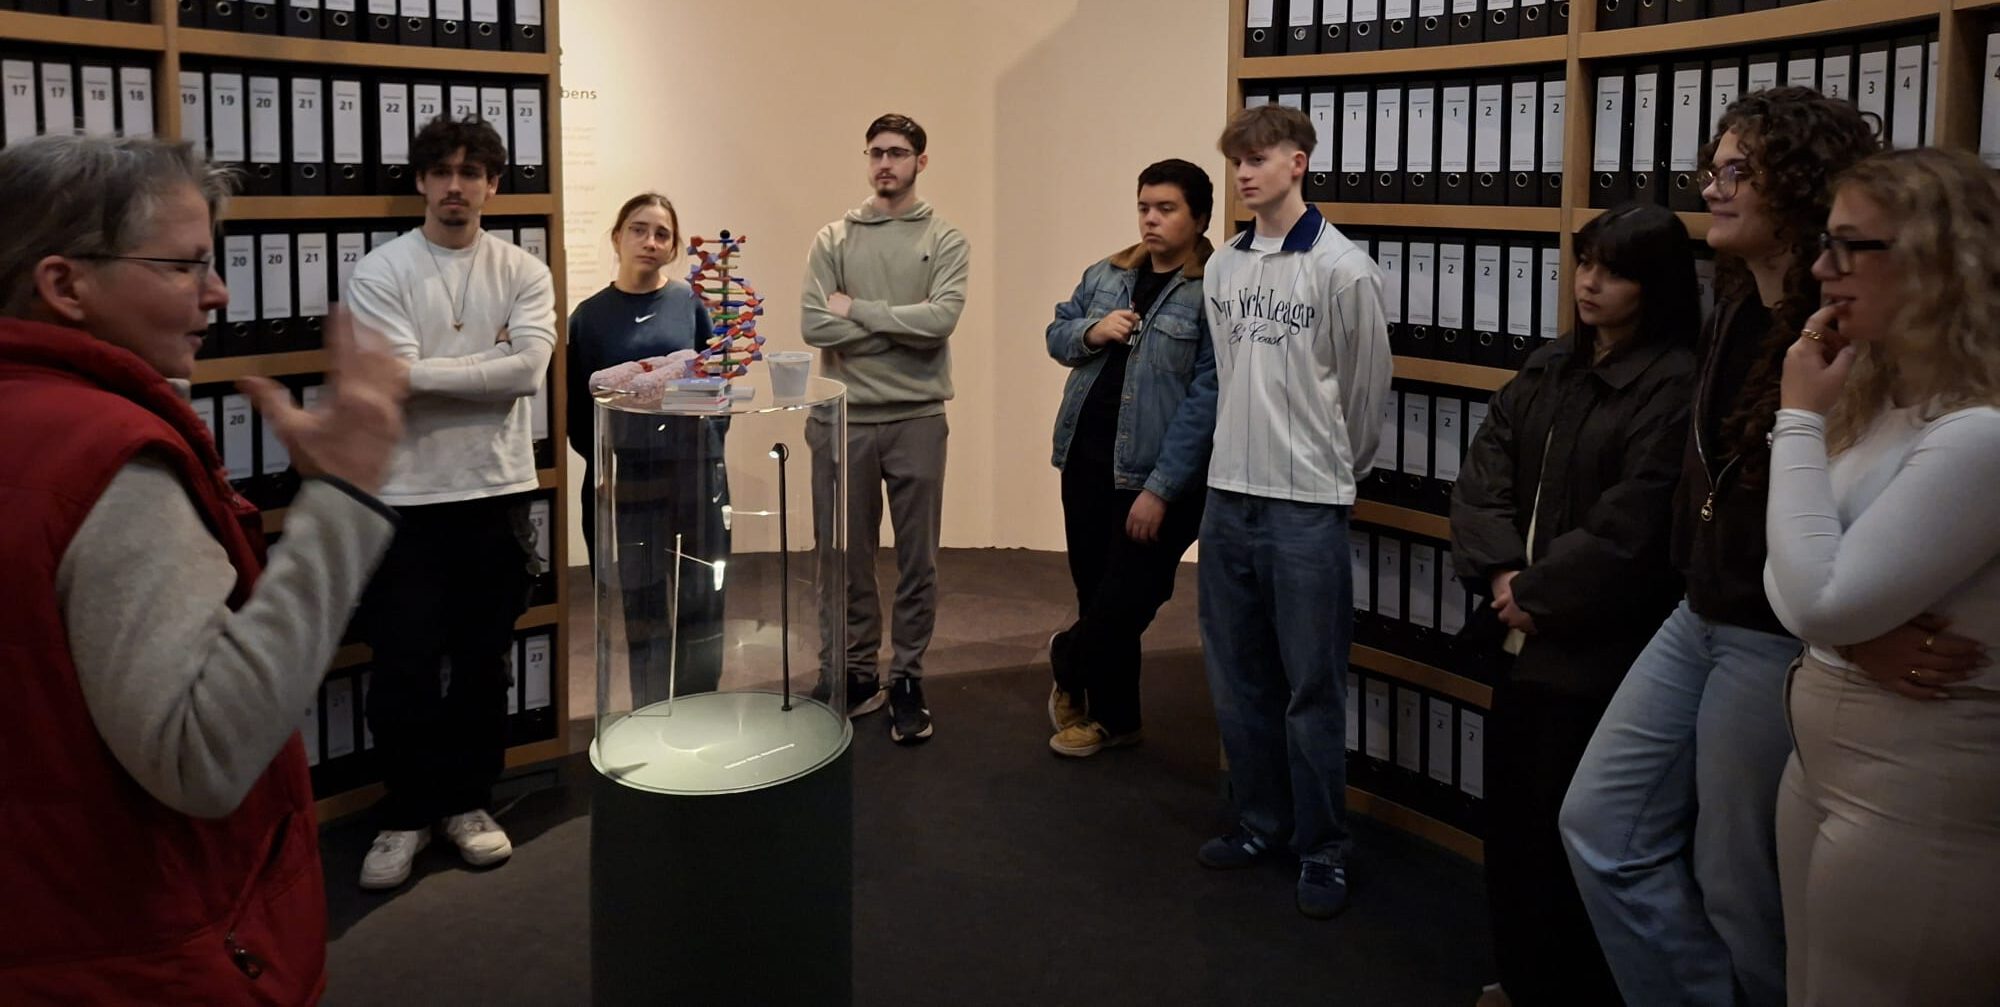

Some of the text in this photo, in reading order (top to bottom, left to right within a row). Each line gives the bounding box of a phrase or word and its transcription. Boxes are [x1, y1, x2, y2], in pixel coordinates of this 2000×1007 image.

[1868, 81, 1875, 94] 3
[1903, 76, 1910, 90] 4
[12, 85, 27, 96] 17
[51, 87, 65, 98] 17
[129, 90, 144, 101] 18
[1832, 84, 1838, 97] 3
[182, 93, 197, 105] 19
[220, 95, 234, 106] 19
[256, 98, 271, 108] 20
[298, 98, 313, 109] 21
[1642, 97, 1648, 108] 2
[1683, 94, 1690, 105] 2
[1721, 93, 1727, 105] 3
[339, 101, 353, 110] 21
[385, 103, 400, 113] 22
[420, 104, 434, 114] 23
[1520, 104, 1526, 114] 2
[1553, 104, 1559, 113] 2
[1606, 100, 1613, 110] 2
[487, 106, 500, 116] 23
[519, 107, 532, 117] 23
[1352, 111, 1357, 120] 1
[1385, 109, 1390, 118] 1
[1418, 109, 1422, 118] 1
[1453, 107, 1457, 117] 1
[1485, 106, 1492, 116] 2
[1319, 112, 1324, 121] 1
[232, 256, 246, 267] 20
[268, 254, 283, 265] 20
[304, 253, 319, 263] 21
[344, 252, 357, 262] 22
[1387, 261, 1392, 270] 1
[1419, 262, 1423, 272] 1
[1448, 264, 1454, 274] 2
[1484, 266, 1490, 276] 2
[1517, 268, 1523, 278] 2
[1551, 270, 1558, 280] 2
[230, 415, 245, 425] 20
[1413, 413, 1418, 422] 1
[1444, 418, 1451, 427] 2
